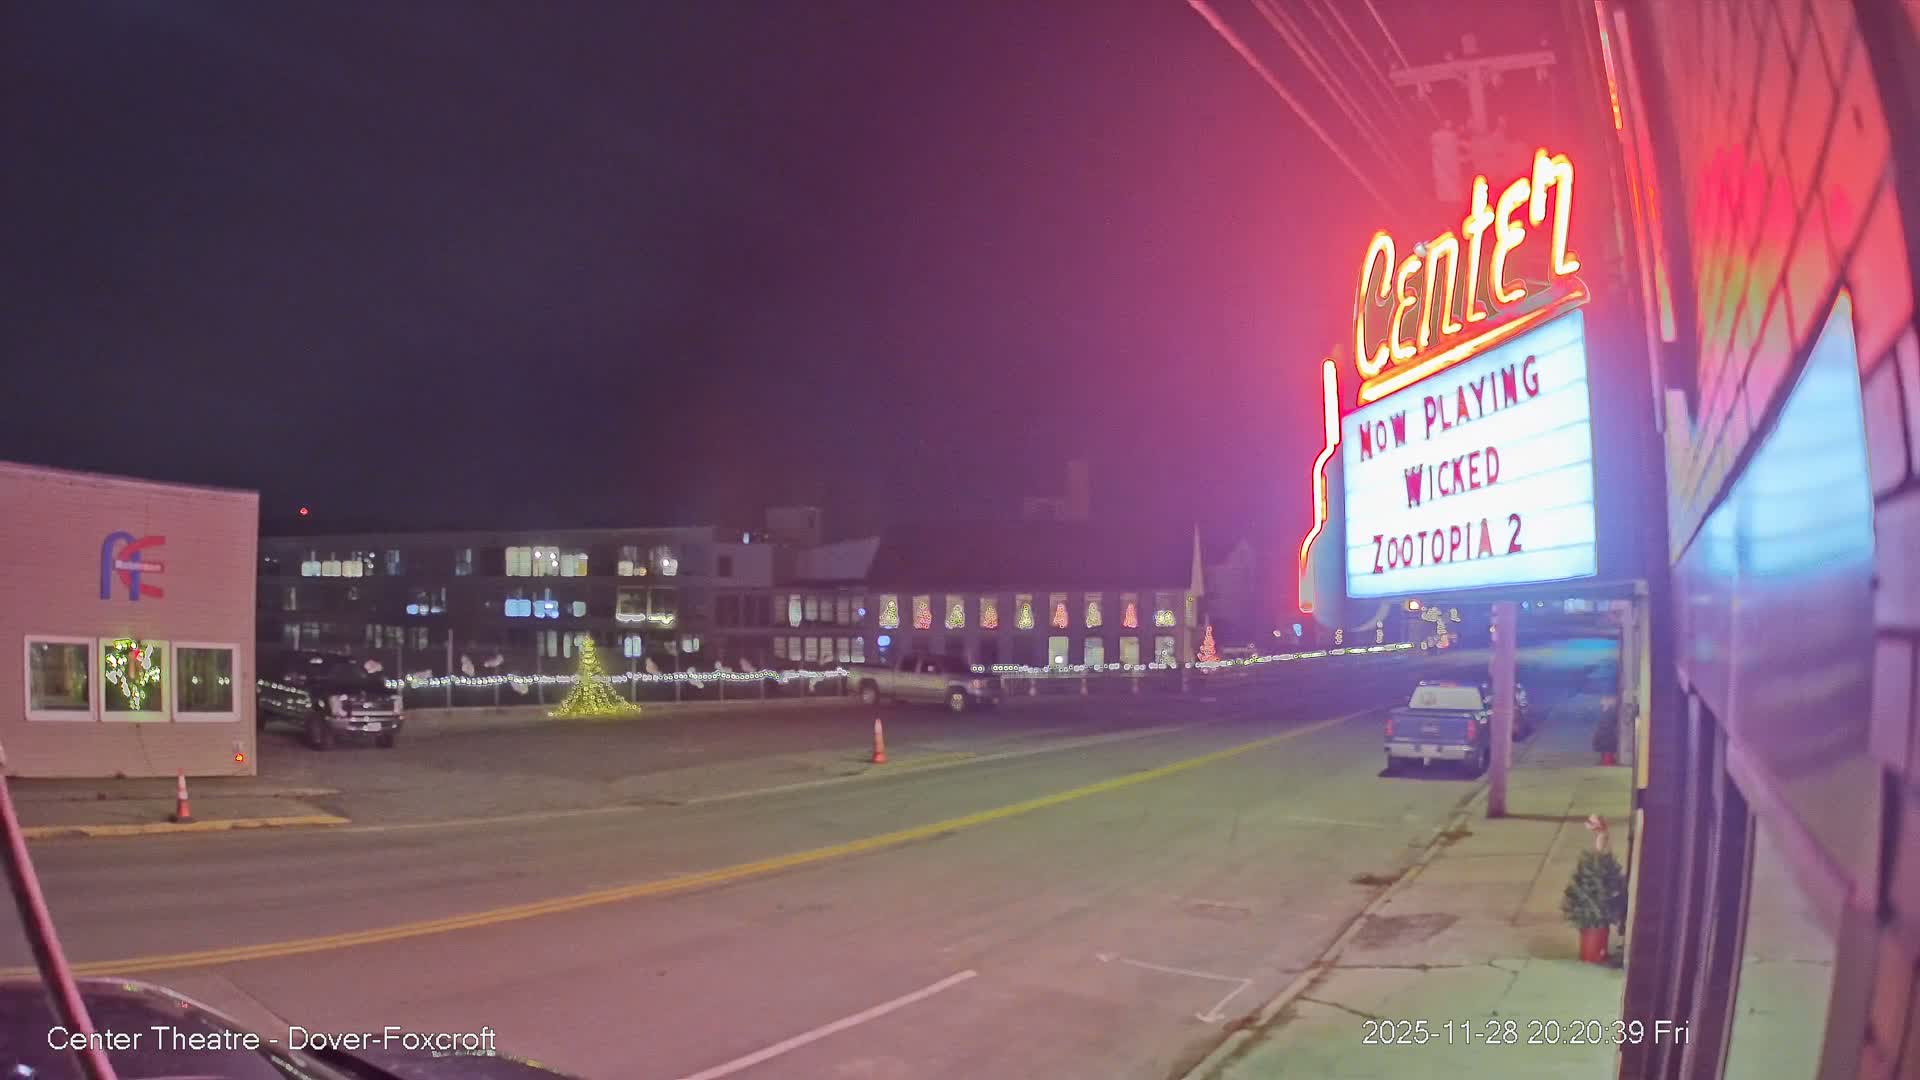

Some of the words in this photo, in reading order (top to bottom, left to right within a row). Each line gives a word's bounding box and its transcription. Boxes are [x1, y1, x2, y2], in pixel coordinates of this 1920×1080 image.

[1359, 409, 1407, 462] NOW
[1423, 374, 1541, 440] PLAYING
[1404, 446, 1501, 509] WICKED
[1372, 518, 1494, 575] ZOOTOPIA
[1507, 512, 1523, 555] 2
